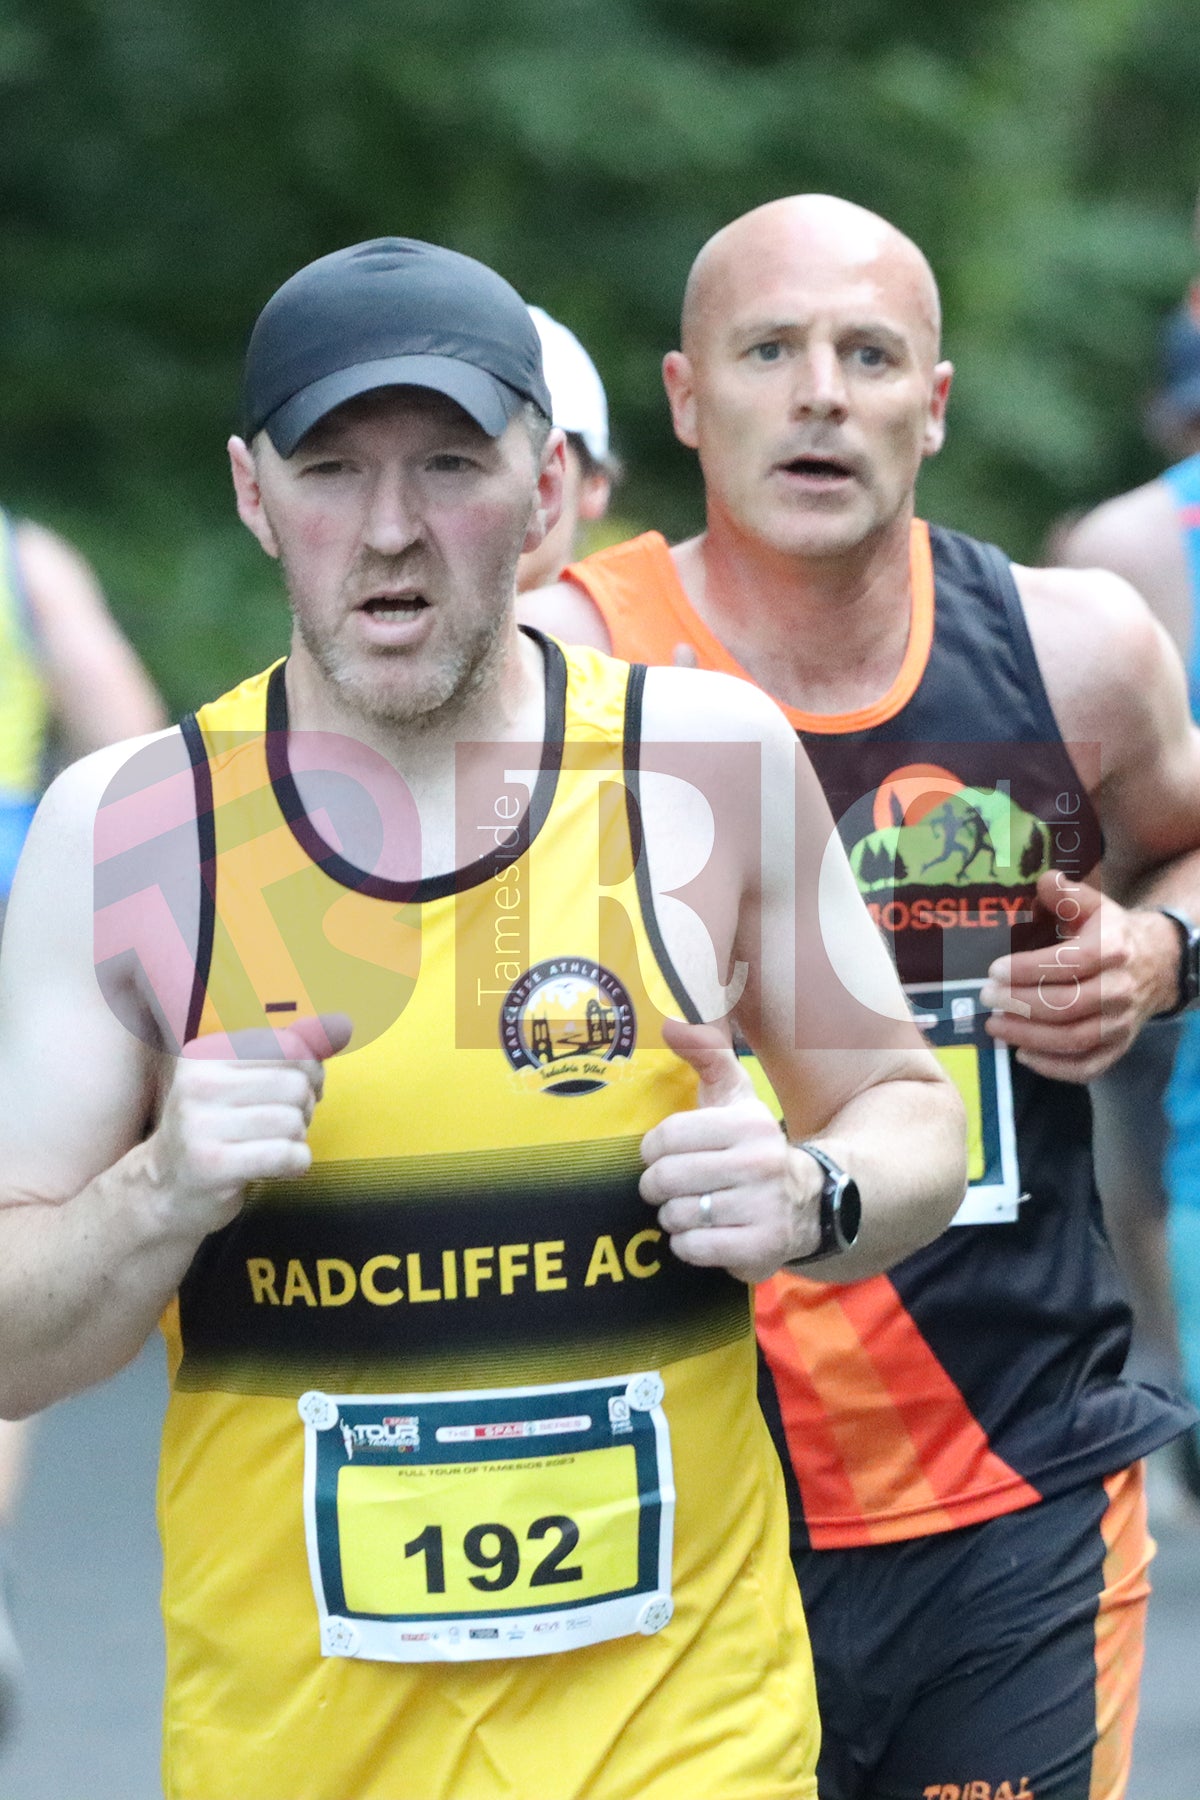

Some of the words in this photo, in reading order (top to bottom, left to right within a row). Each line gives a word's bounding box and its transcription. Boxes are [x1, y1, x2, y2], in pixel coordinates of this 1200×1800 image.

[504, 971, 543, 1060] RADCLIFFE
[549, 961, 620, 998] ATHLETIC
[619, 1004, 633, 1048] CLUB
[246, 1239, 568, 1308] RADCLIFFE
[584, 1228, 662, 1288] AC
[398, 1469, 426, 1477] FULL
[430, 1467, 462, 1477] TOUR
[463, 1466, 478, 1476] OF
[483, 1460, 543, 1473] TAMESIDE
[404, 1515, 583, 1595] 192
